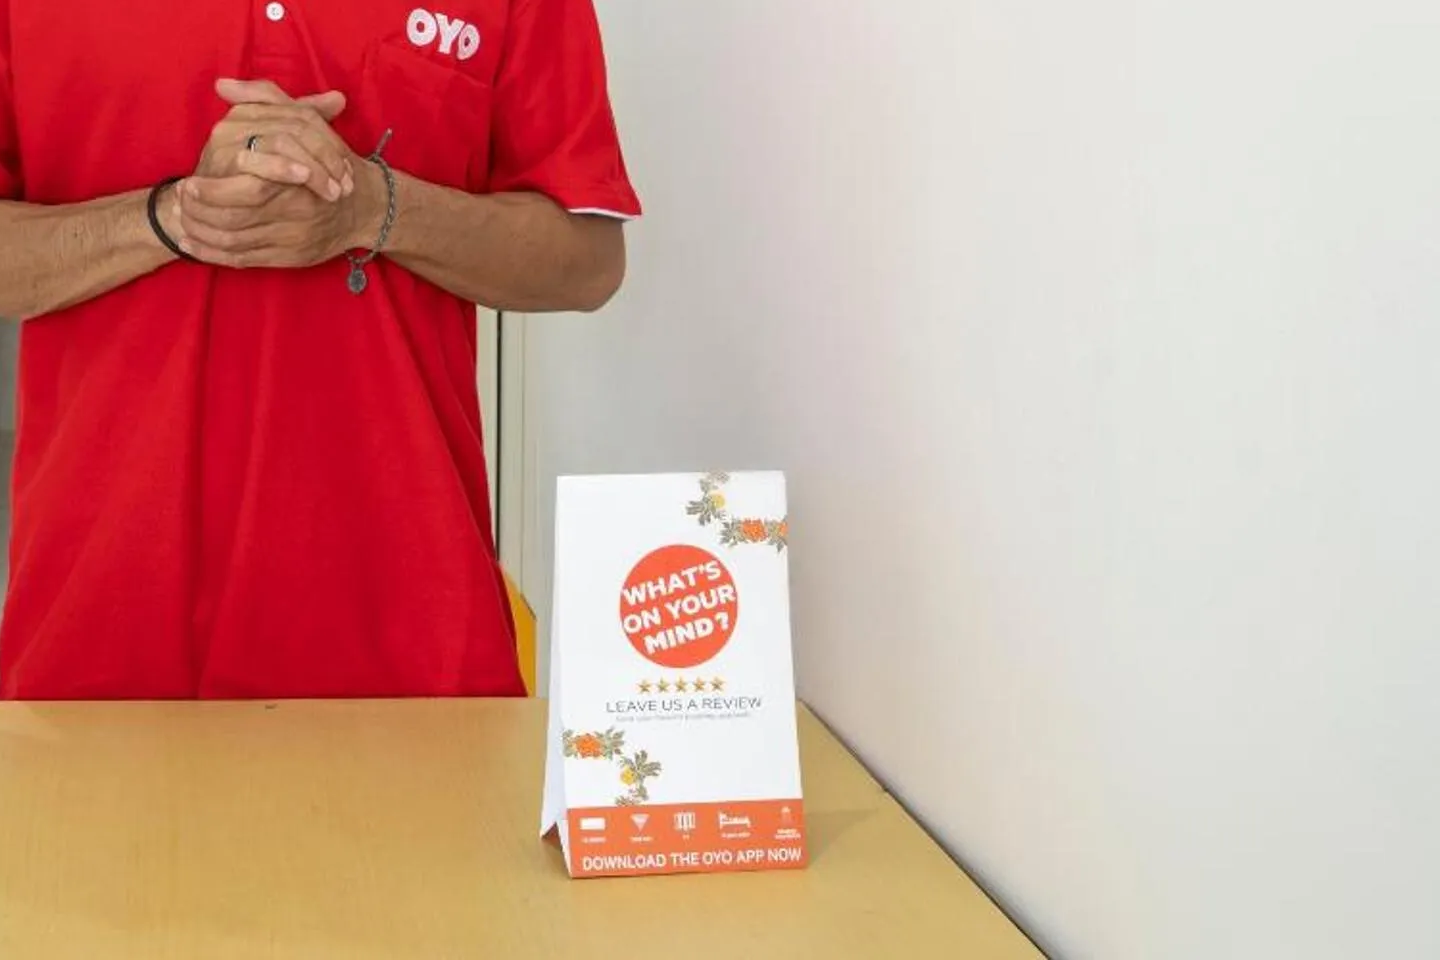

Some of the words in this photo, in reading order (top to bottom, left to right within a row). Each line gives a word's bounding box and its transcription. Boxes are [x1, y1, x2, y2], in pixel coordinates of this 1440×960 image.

[406, 7, 480, 60] OYO
[622, 559, 721, 606] WHAT'S
[623, 607, 662, 634] ON
[665, 583, 737, 620] YOUR
[606, 699, 657, 713] LEAVE
[661, 699, 682, 711] US
[687, 698, 698, 710] A
[702, 696, 761, 710] REVIEW
[582, 854, 666, 871] DOWNLOAD
[670, 851, 700, 867] THE
[702, 850, 732, 865] OYO
[736, 848, 765, 863] APP
[767, 847, 802, 863] NOW
